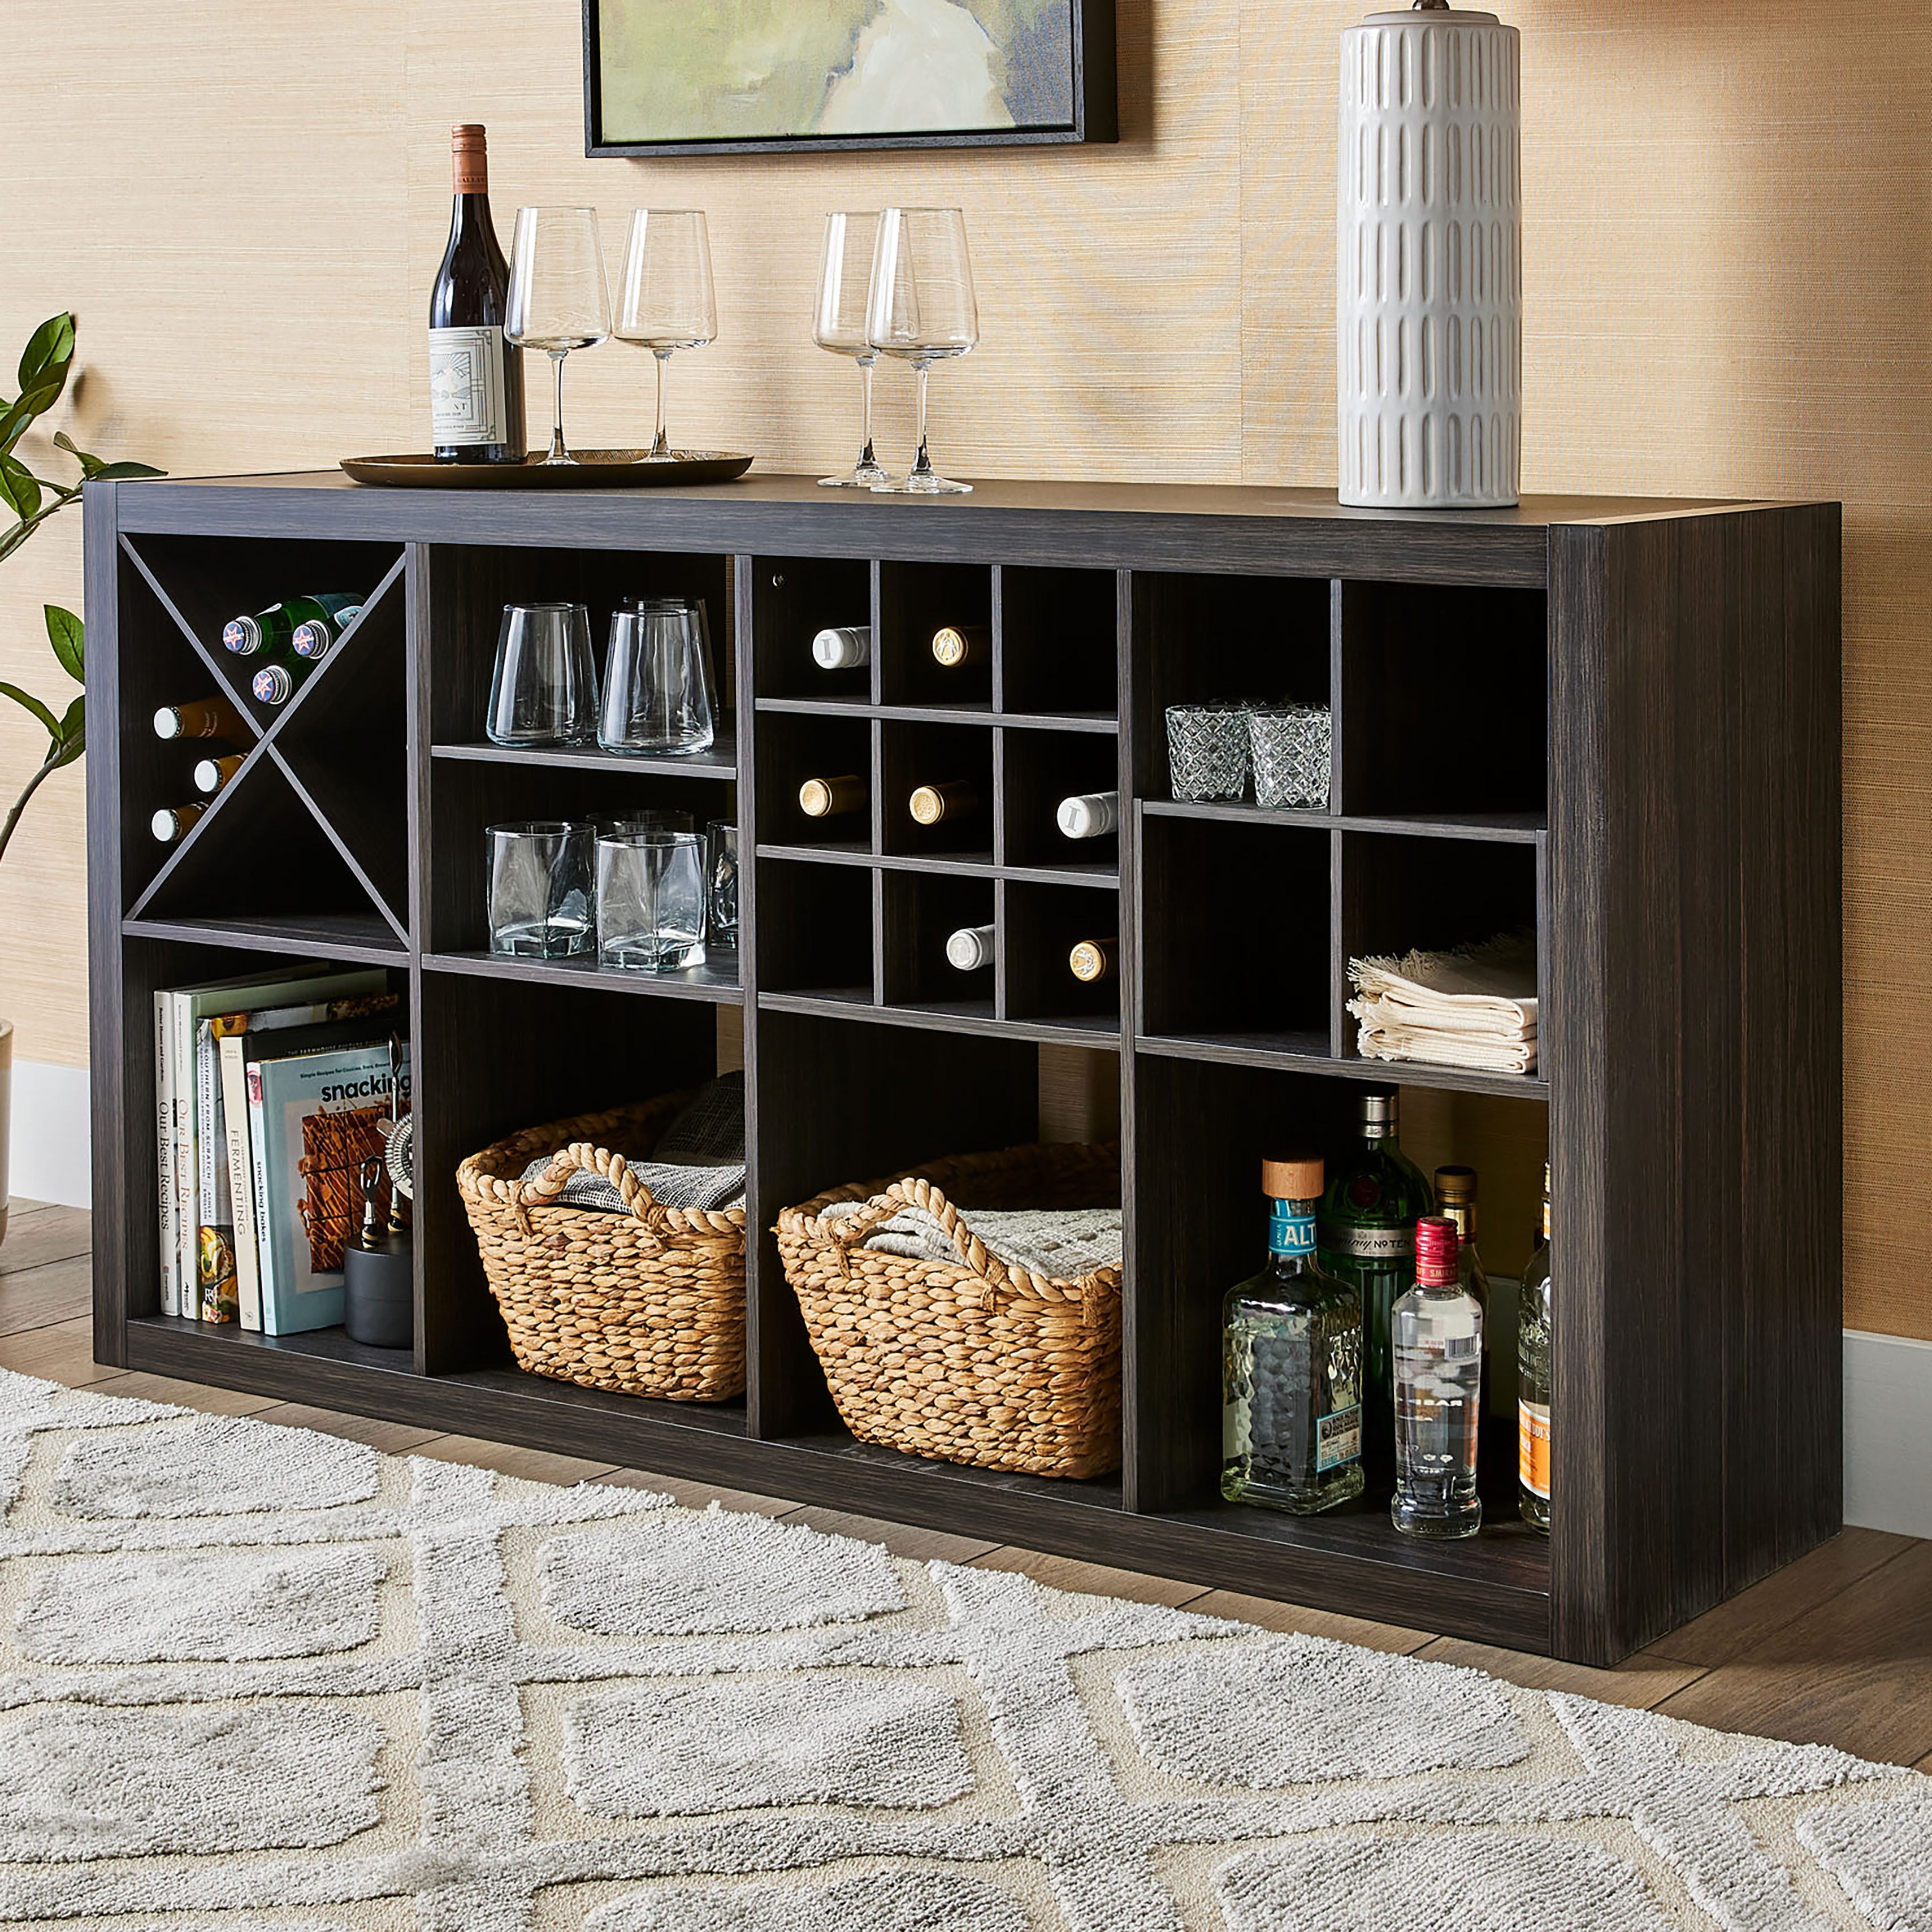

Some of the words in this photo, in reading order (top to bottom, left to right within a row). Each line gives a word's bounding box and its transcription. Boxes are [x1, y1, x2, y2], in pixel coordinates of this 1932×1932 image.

[159, 1102, 169, 1132] Our
[159, 1137, 169, 1168] Best
[158, 1174, 171, 1230] Recipes
[231, 1129, 245, 1236] FERMENTING
[181, 1187, 190, 1250] RECIPES
